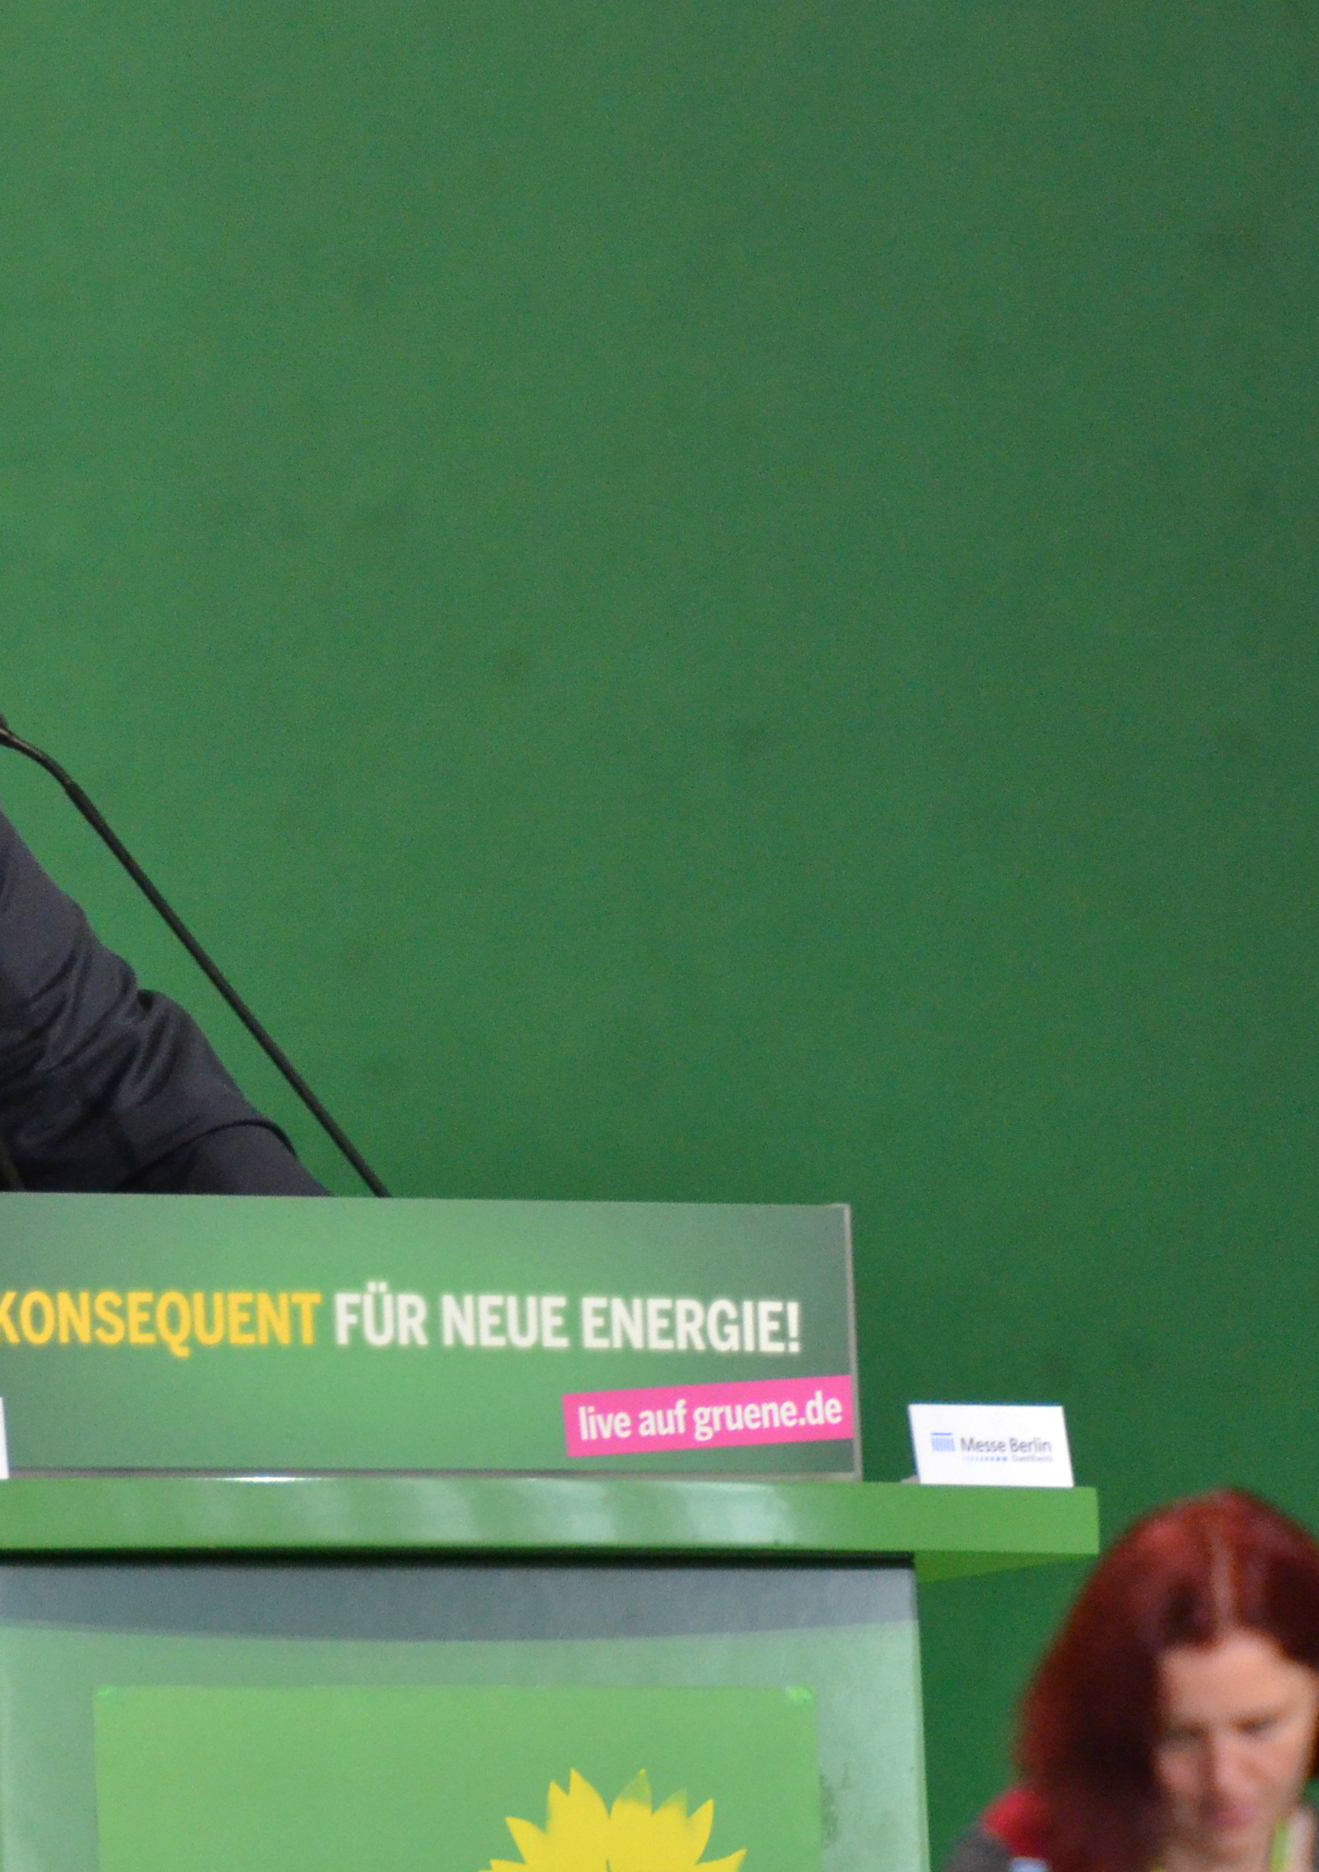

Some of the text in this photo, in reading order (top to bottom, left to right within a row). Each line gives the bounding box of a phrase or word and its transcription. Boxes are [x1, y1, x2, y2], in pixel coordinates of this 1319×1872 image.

[334, 1280, 428, 1346] FÜR
[441, 1294, 569, 1349] NEUE
[581, 1297, 800, 1353] ENERGIE!
[579, 1389, 843, 1442] live auf gruene.de
[961, 1438, 1051, 1453] Messe Berlin
